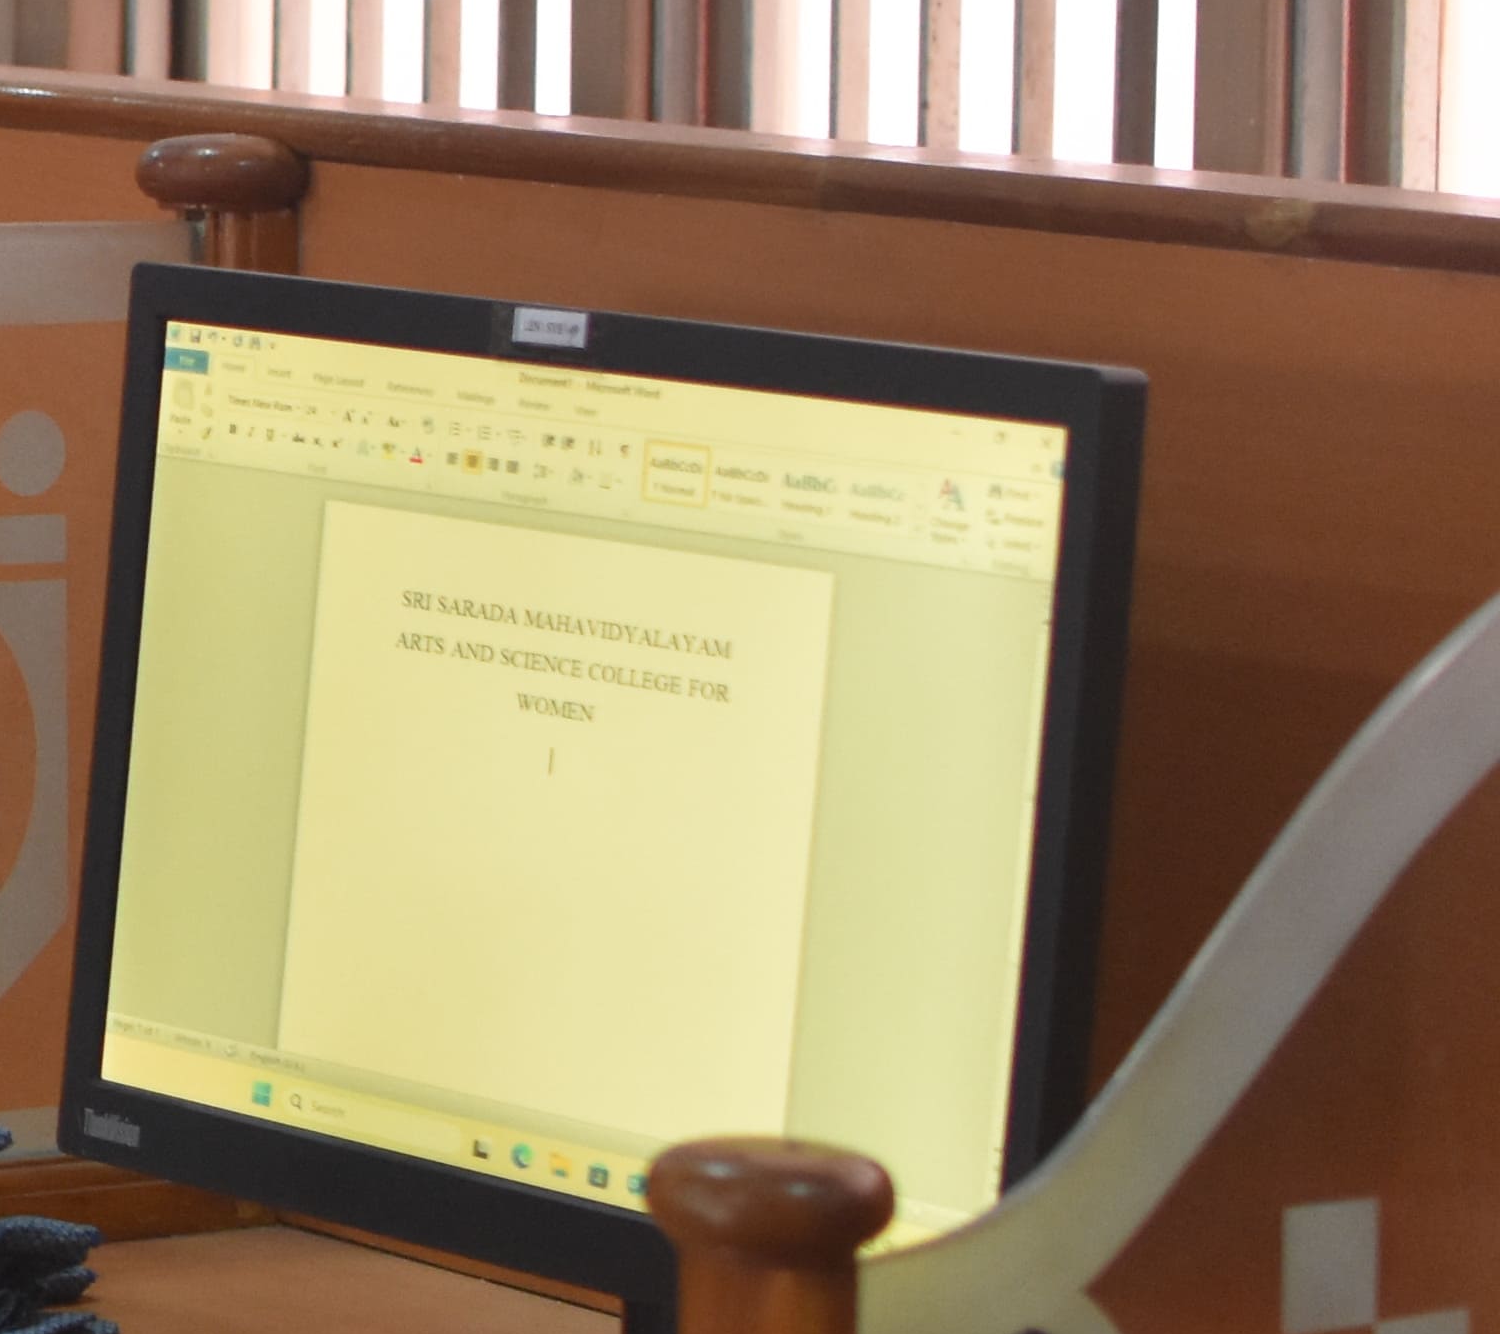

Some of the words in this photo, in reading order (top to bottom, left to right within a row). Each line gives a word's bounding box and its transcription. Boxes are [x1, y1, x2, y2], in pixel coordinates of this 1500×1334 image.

[401, 590, 432, 611] SRI
[437, 596, 518, 626] SARADA
[523, 608, 734, 661] MAHAVIDYALAYAM
[396, 632, 445, 656] ARTS
[451, 641, 494, 664] AND
[499, 648, 583, 680] SCIENCE
[587, 663, 682, 697] COLLEGE
[687, 679, 731, 704] FOR
[517, 691, 597, 723] WOMEN
